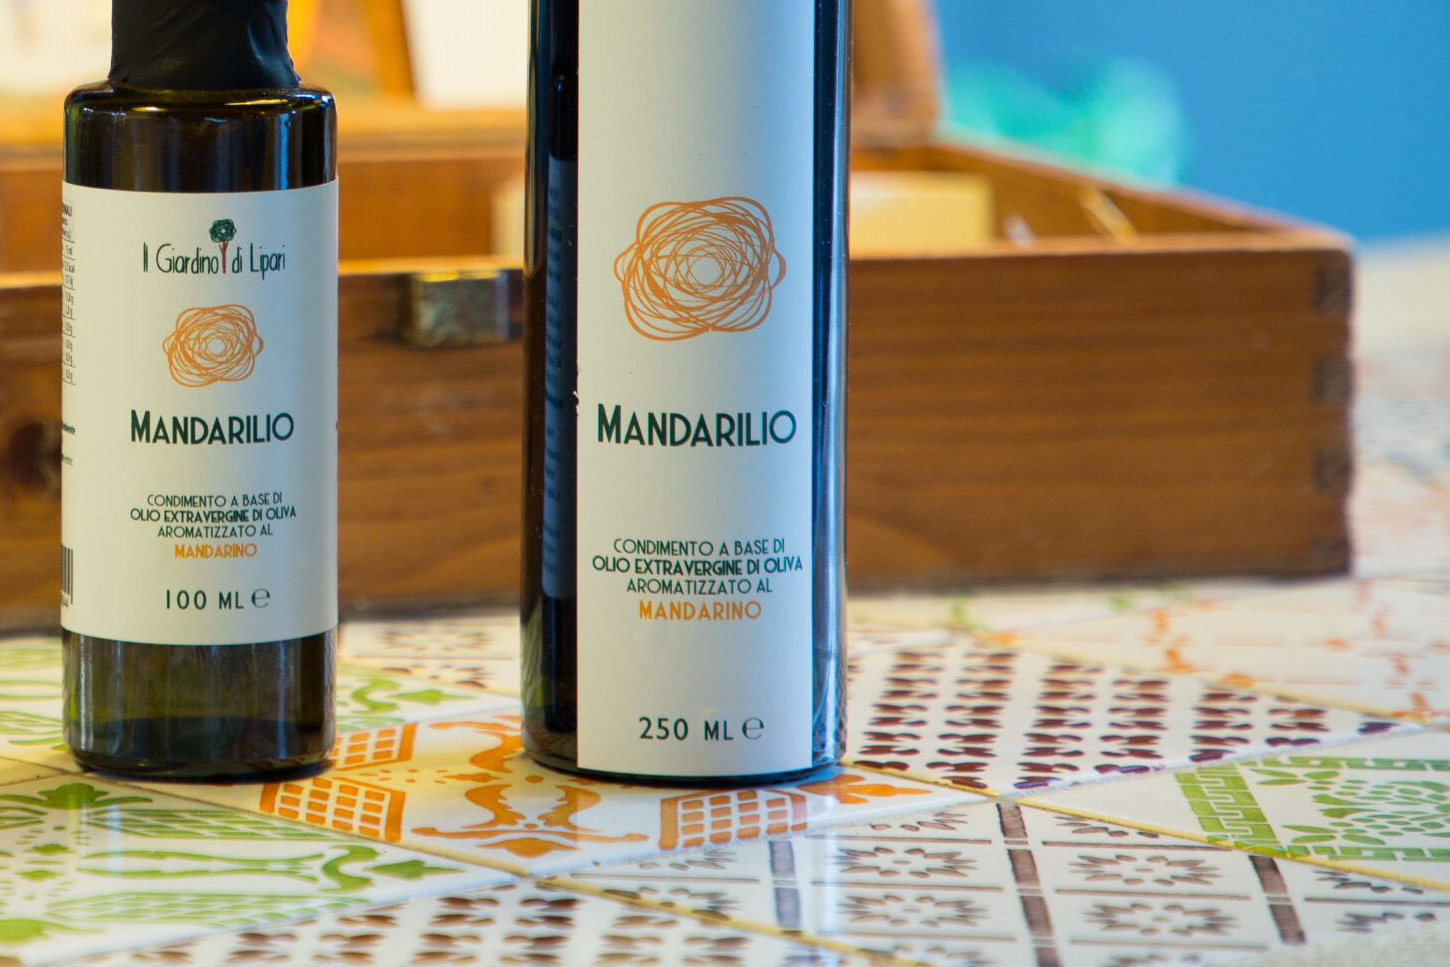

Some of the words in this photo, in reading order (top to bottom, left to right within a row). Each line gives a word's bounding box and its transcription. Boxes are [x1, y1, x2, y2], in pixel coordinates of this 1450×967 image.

[156, 243, 219, 274] Giardino
[232, 247, 243, 273] di
[250, 242, 285, 280] Lipari
[147, 493, 226, 508] CONDIMENTO
[230, 494, 239, 507] A
[242, 493, 270, 506] BASE
[273, 491, 282, 505] DI
[130, 509, 160, 523] OLIO
[252, 509, 262, 521] DI
[266, 506, 297, 519] OLIVA
[157, 524, 256, 538] AROMATIZZATO
[260, 523, 273, 536] AL
[174, 543, 257, 559] MANDARINO
[613, 538, 713, 556] CONDIMENTO
[719, 542, 729, 556] A
[735, 540, 769, 555] BASE
[774, 538, 785, 553] DI
[592, 556, 630, 573] OLIO
[747, 558, 759, 573] DI
[764, 556, 803, 573] OLIVA
[627, 578, 751, 595] AROMATIZZATO
[757, 578, 773, 593] AL
[166, 590, 207, 610] 100
[219, 590, 244, 610] ML
[639, 601, 762, 621] MANDARINO
[639, 717, 688, 741] 250
[704, 720, 733, 741] ML
